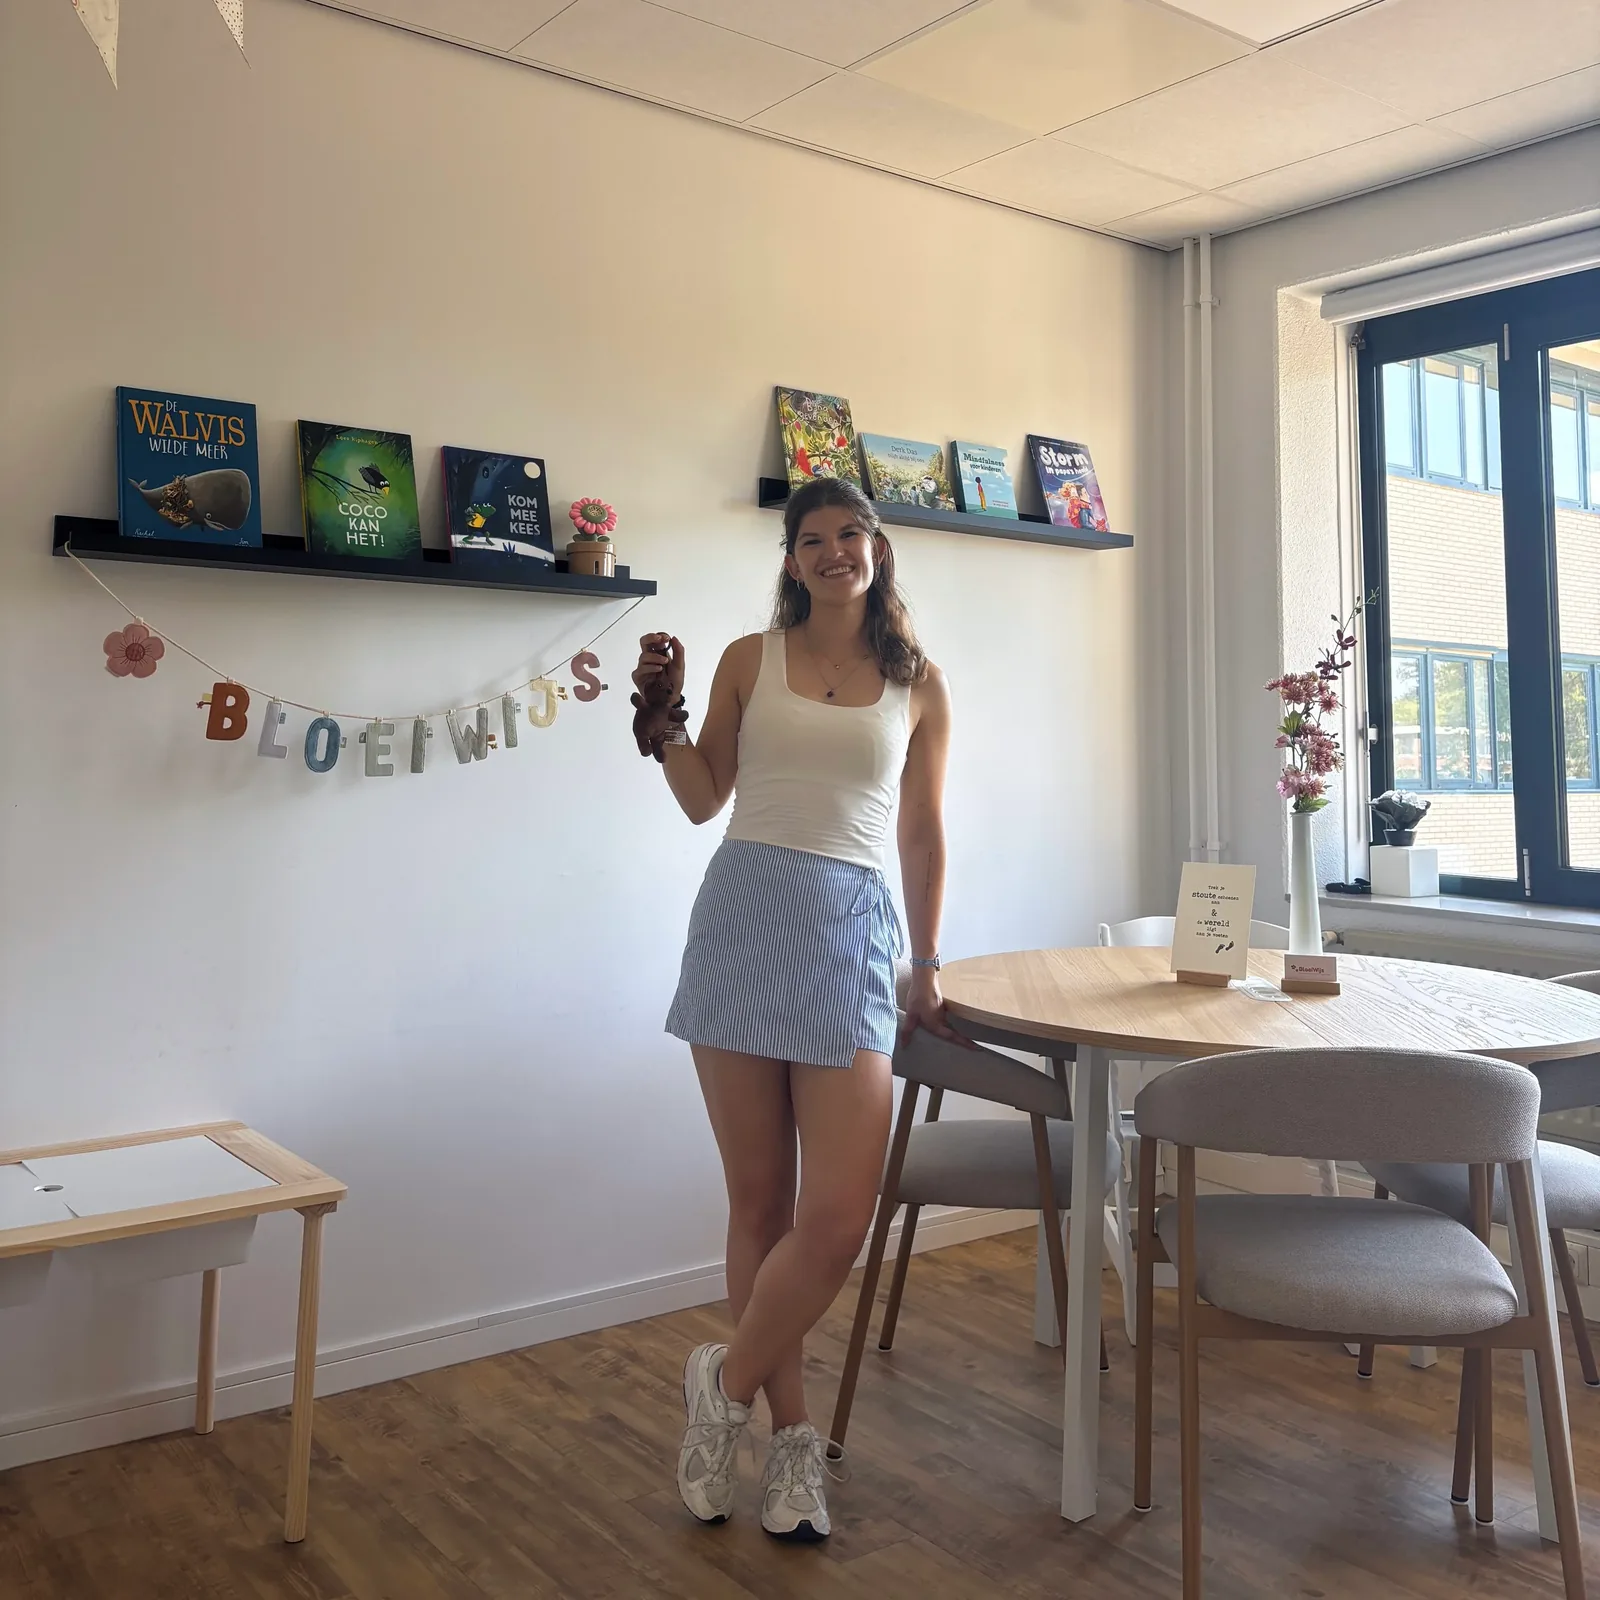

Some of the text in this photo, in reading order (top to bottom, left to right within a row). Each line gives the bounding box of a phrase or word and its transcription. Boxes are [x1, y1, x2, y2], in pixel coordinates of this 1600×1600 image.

[165, 399, 178, 413] DE
[128, 399, 246, 447] WALVIS
[149, 437, 229, 460] WILDE MEER
[963, 452, 1005, 467] Mindfulness
[1039, 445, 1089, 468] Storm
[507, 494, 538, 509] KOM
[338, 502, 388, 519] COCO
[510, 508, 538, 522] MEE
[349, 517, 380, 533] KAN
[509, 521, 541, 536] KEES
[346, 531, 385, 547] HET!
[1191, 891, 1217, 899] stoute
[1211, 908, 1218, 917] &
[1204, 920, 1230, 928] wereld
